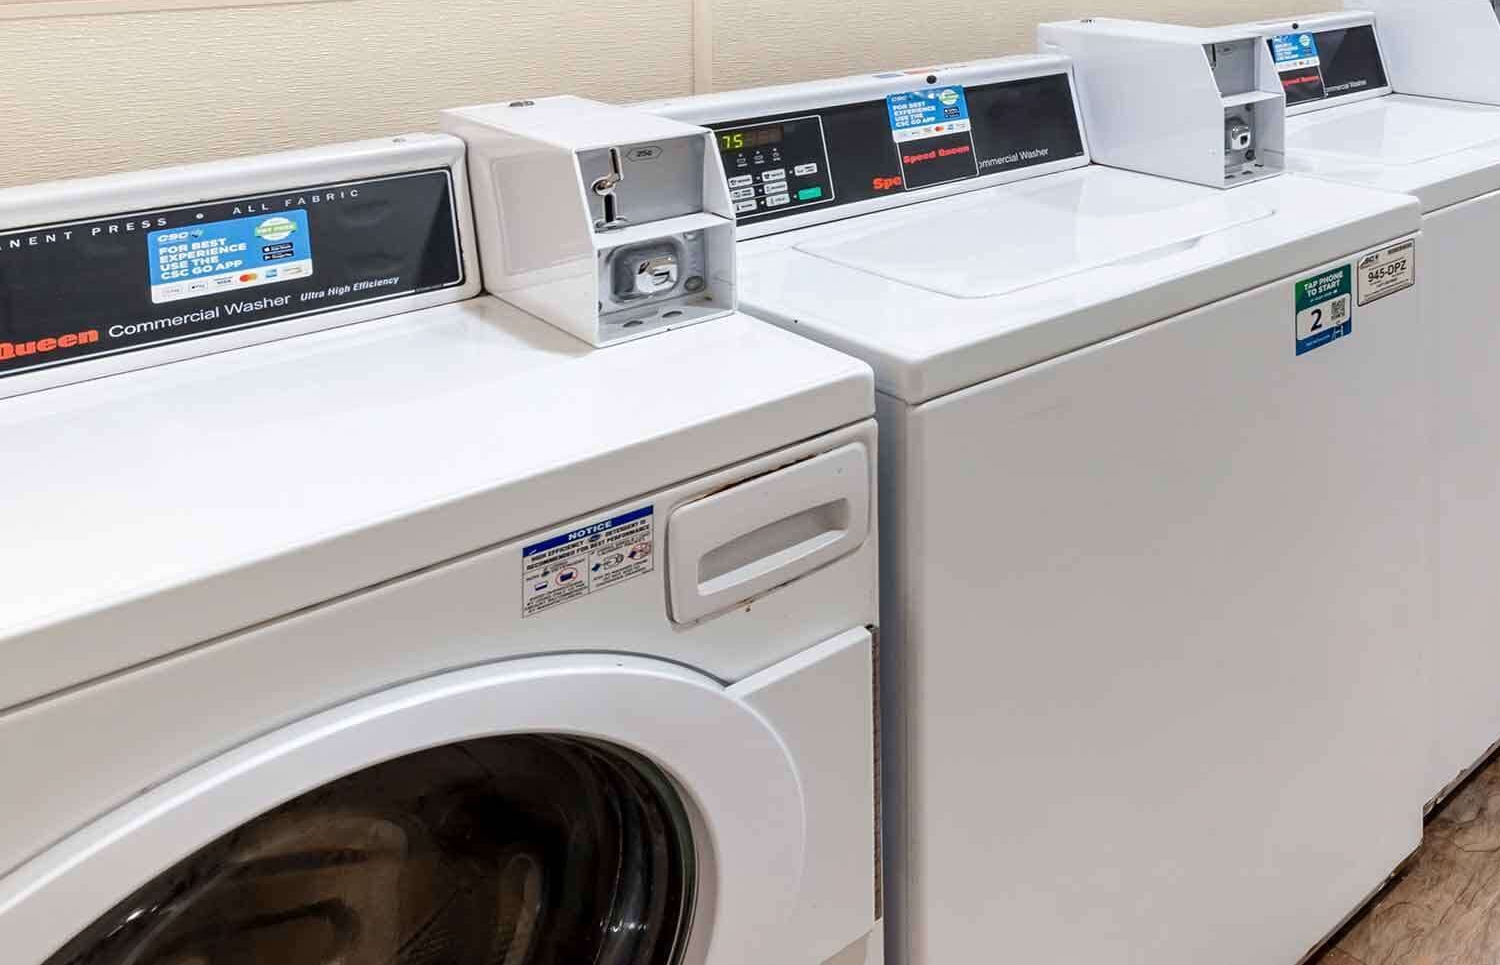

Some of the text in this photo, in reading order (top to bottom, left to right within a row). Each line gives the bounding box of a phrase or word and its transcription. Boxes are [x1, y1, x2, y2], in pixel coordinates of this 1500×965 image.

[893, 105, 936, 117] EXPERIENCE
[722, 133, 743, 149] 75
[903, 145, 970, 165] Speed Queen
[1019, 148, 1049, 160] Washer
[0, 189, 359, 251] NENT PRESS ALL FABRIC
[159, 238, 227, 255] FOR BEST
[159, 243, 248, 264] EXPERIENCE
[160, 255, 220, 272] USE THE
[161, 259, 243, 280] CSC GO APP
[1367, 259, 1407, 283] 945-DPZ
[1304, 270, 1344, 291] TAP PHONE
[1307, 288, 1317, 297] TO
[1318, 279, 1341, 294] START
[0, 275, 400, 361] Queen Commercial Washer Ultra High Efficiency
[1310, 308, 1323, 332] 2
[568, 520, 613, 541] NOTICE
[526, 550, 575, 571] RECOMMENDED
[576, 545, 589, 554] FOR
[590, 540, 605, 549] BEST
[606, 524, 650, 543] PERFORMANCE
[548, 541, 584, 557] EFFICIENCY
